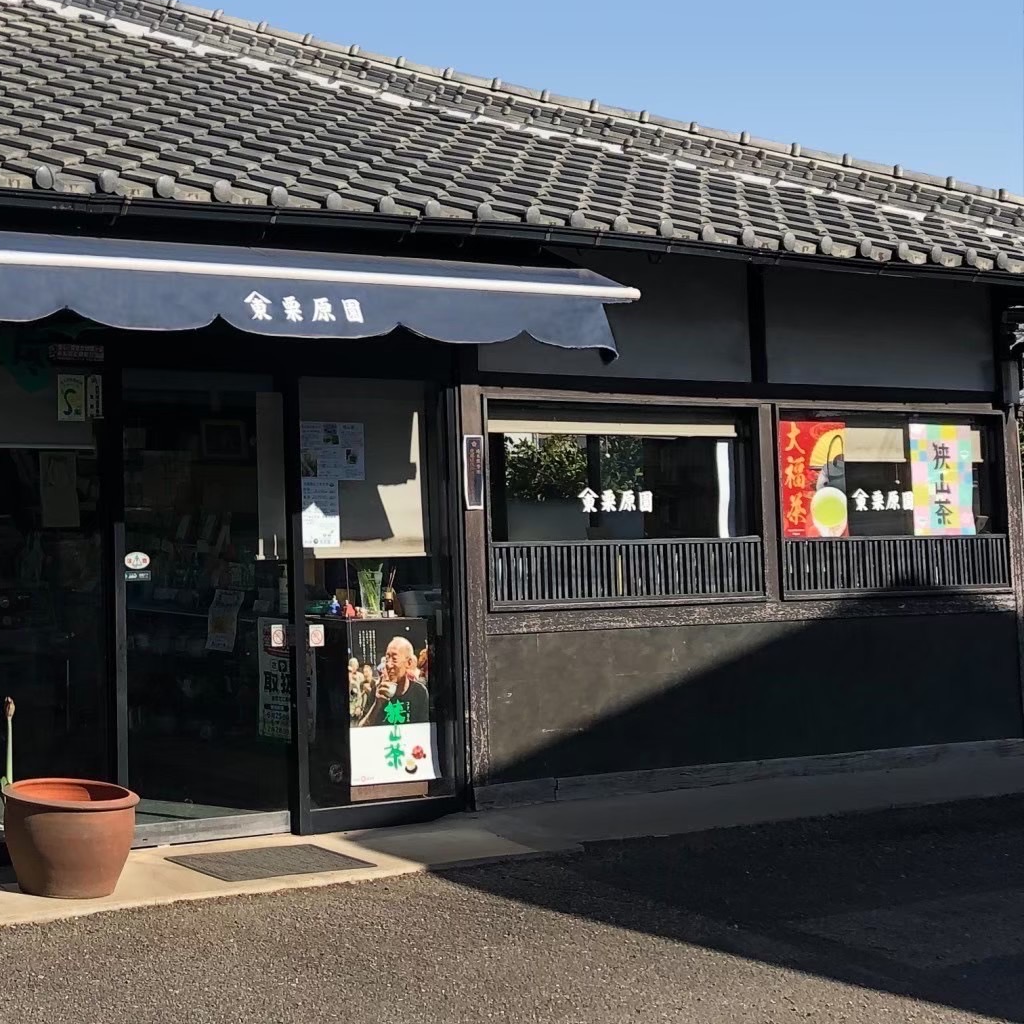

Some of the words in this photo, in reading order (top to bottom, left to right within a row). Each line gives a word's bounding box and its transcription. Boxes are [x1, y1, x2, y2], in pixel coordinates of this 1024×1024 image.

[784, 421, 807, 526] 大福茶
[932, 442, 953, 526] 狭山茶
